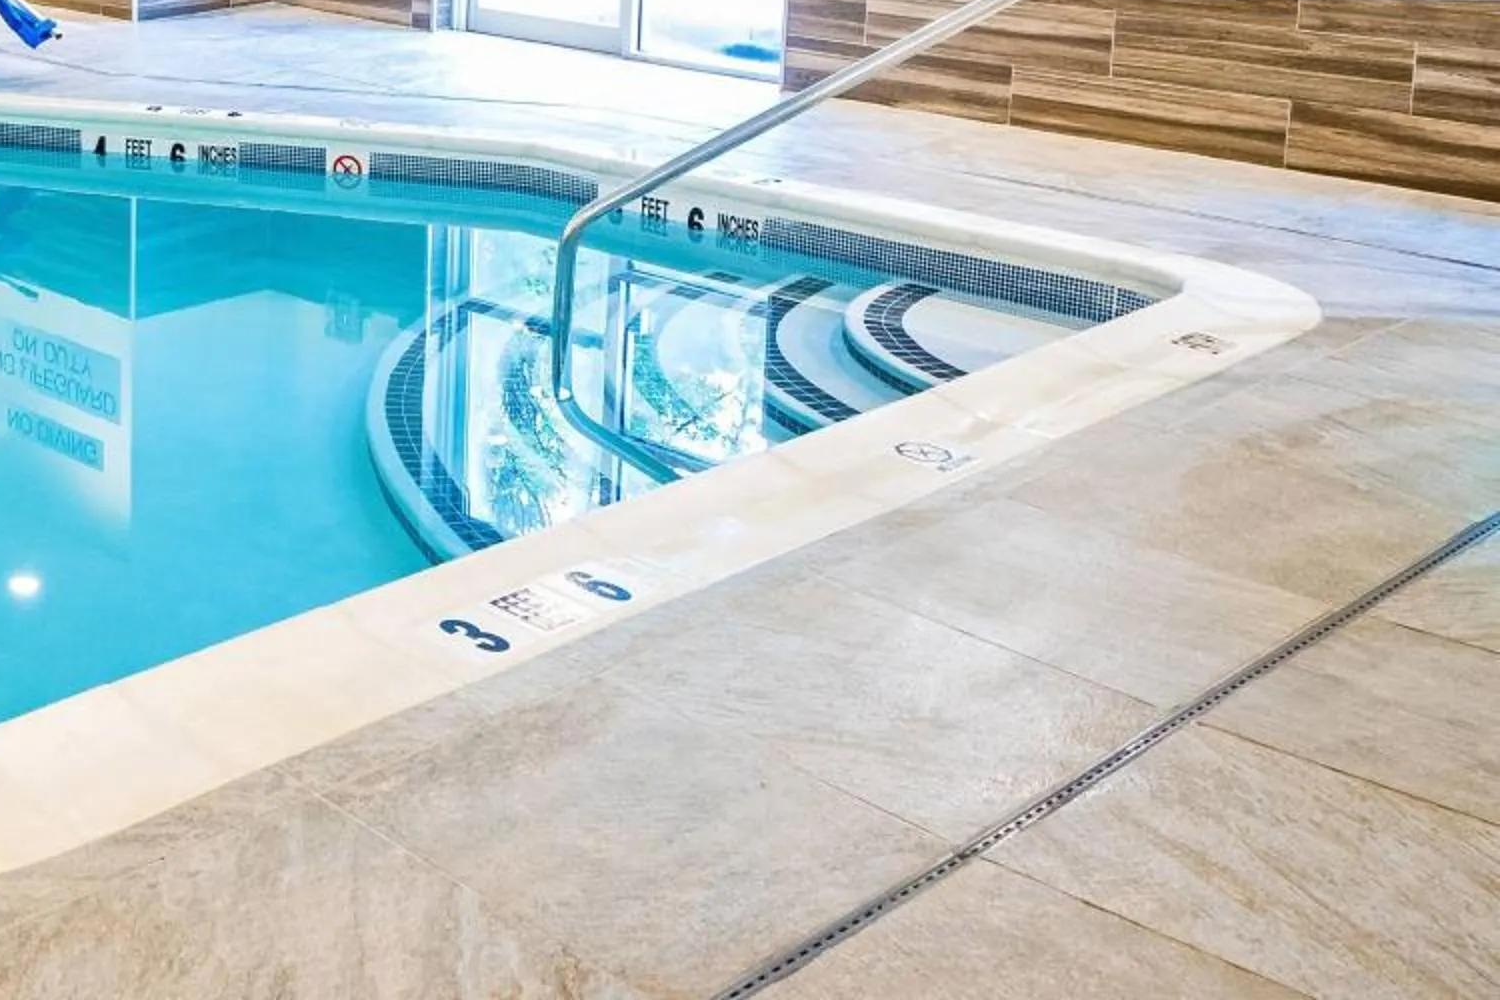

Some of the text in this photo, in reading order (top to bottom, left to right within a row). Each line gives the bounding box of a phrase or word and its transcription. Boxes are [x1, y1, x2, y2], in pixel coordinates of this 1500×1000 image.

[125, 138, 152, 158] FEET
[198, 145, 237, 164] INCHES
[641, 196, 759, 240] FEET 6 INCHES
[439, 618, 510, 652] 3
[564, 571, 632, 601] 6
